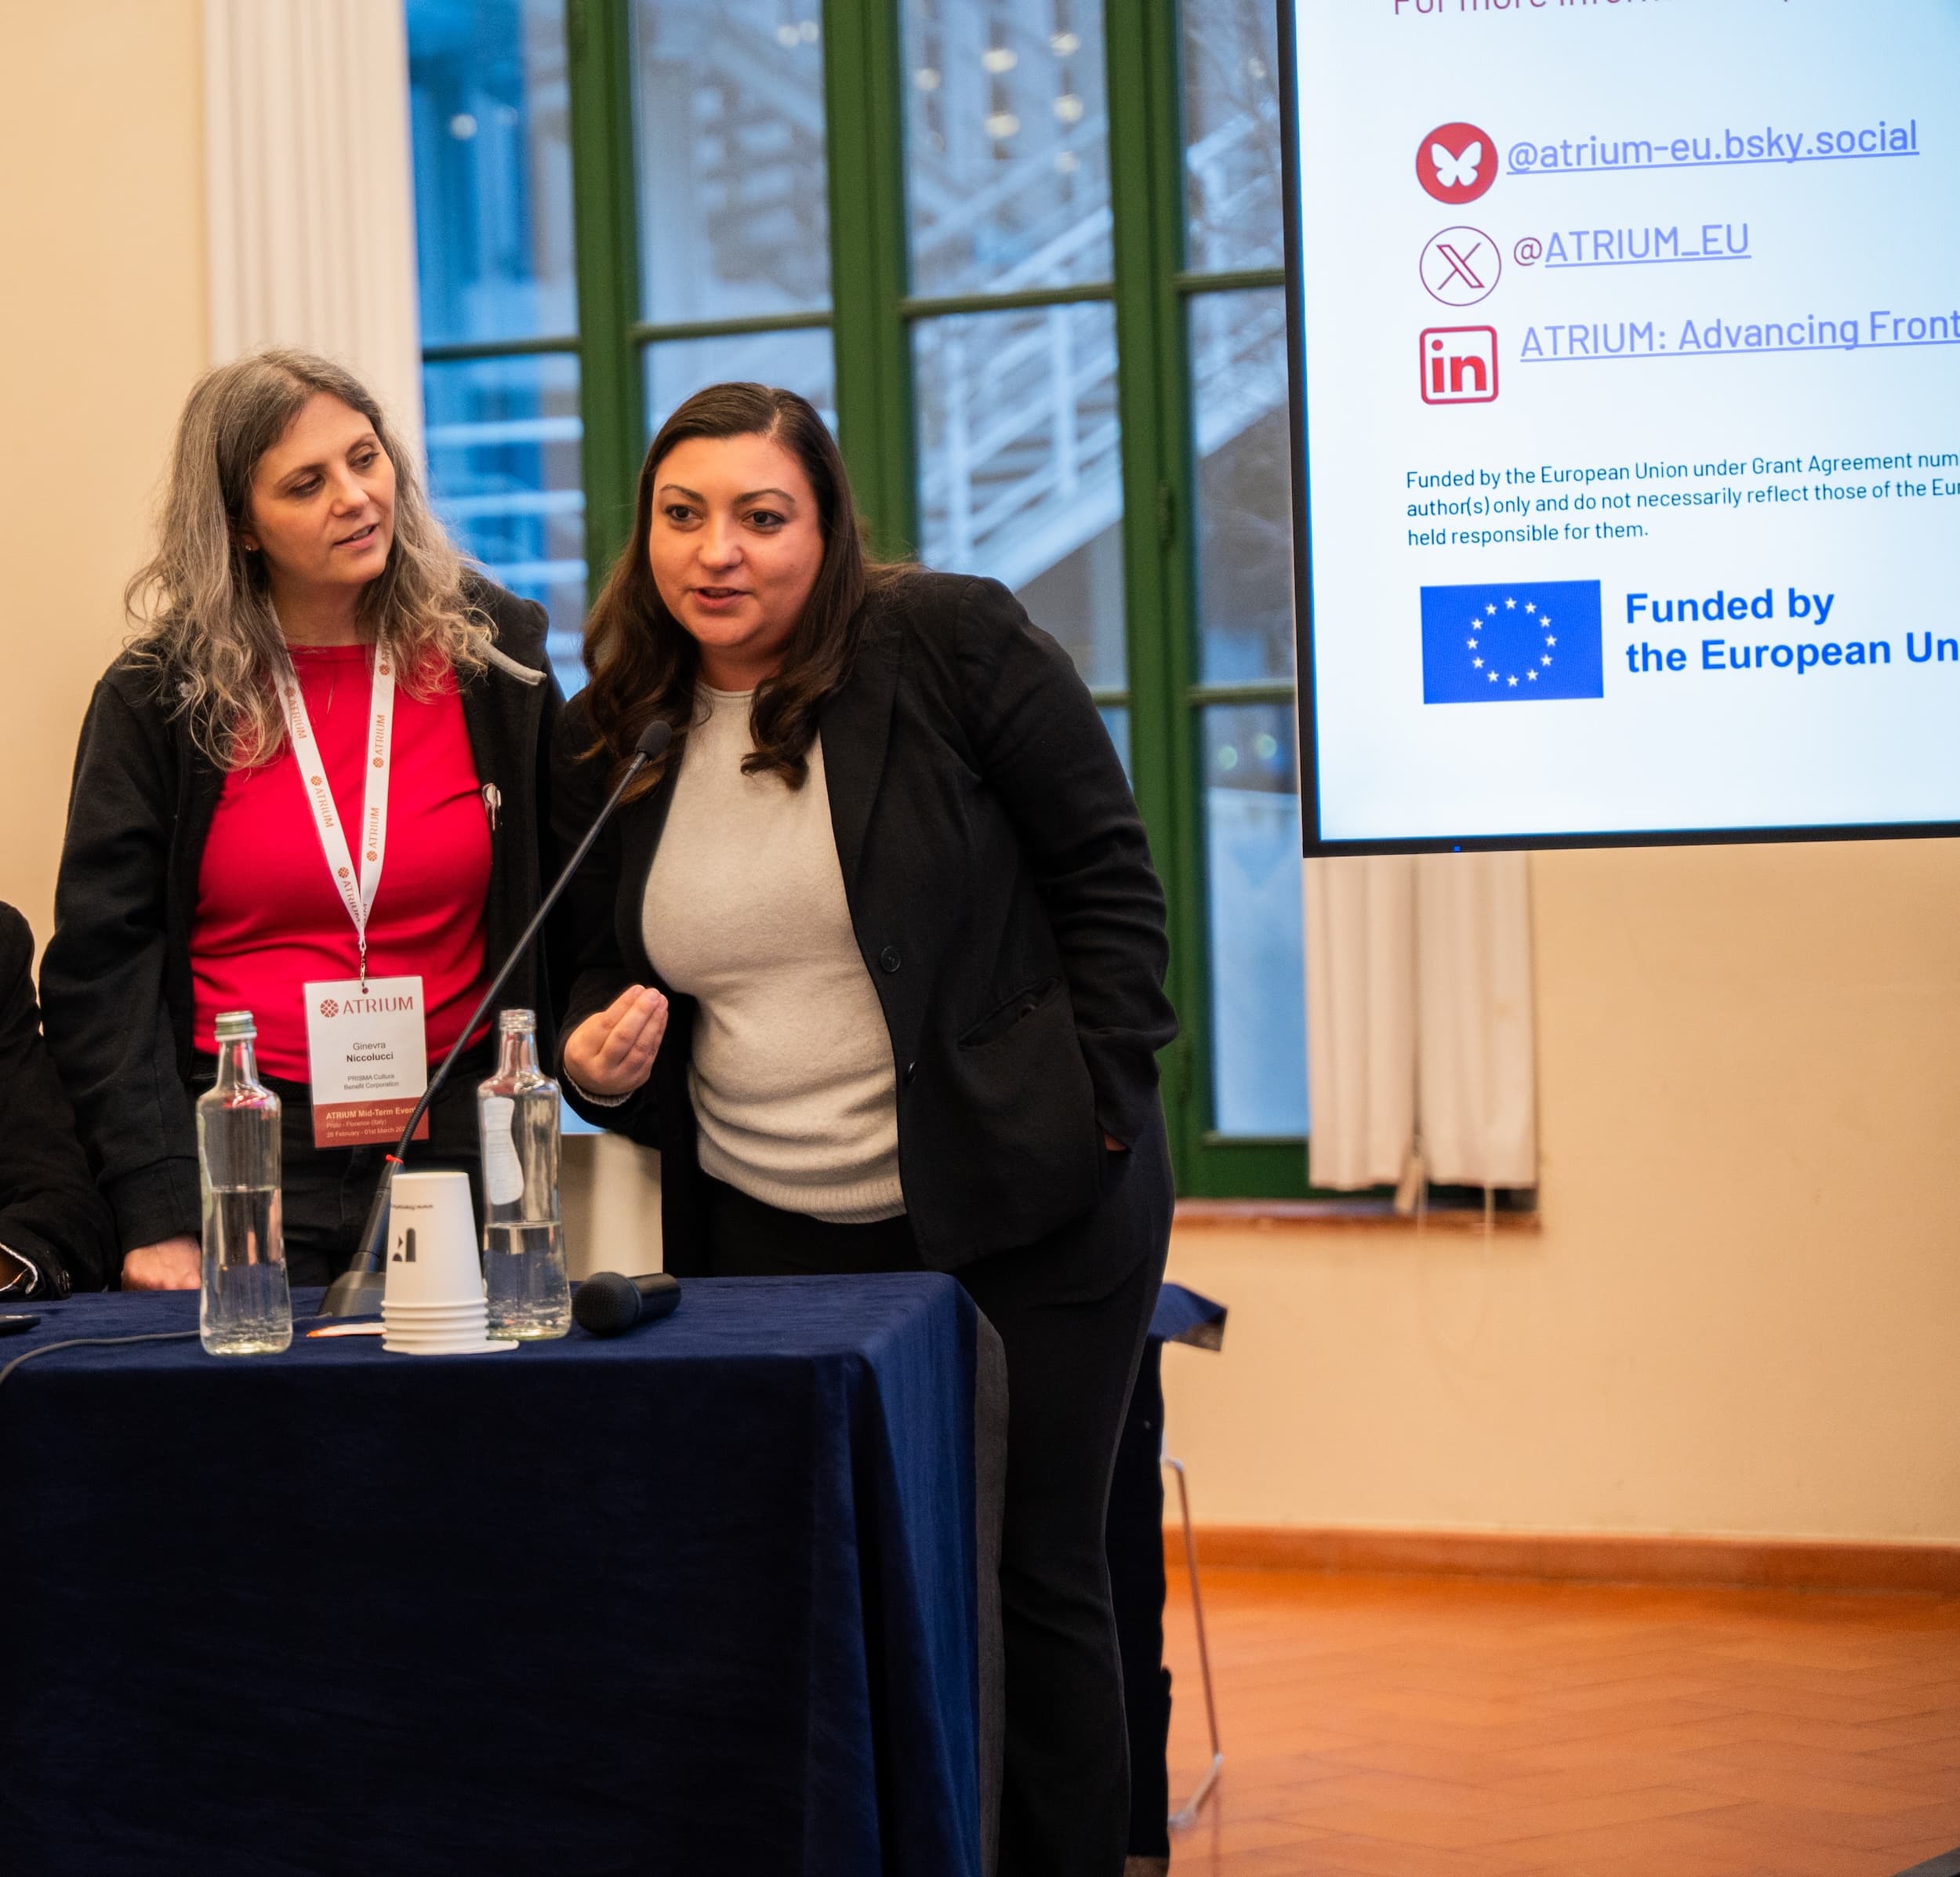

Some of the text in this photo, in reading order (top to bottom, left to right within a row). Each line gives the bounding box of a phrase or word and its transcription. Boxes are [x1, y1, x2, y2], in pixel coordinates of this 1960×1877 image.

[1508, 119, 1917, 173] @atrium-eu.bsky.social
[1513, 223, 1749, 267] @ATRIUM_EU
[1520, 321, 1666, 358] ATRIUM:
[1679, 314, 1859, 351] Advancing
[1406, 470, 1475, 488] Funded
[1479, 469, 1501, 490] by
[1505, 467, 1536, 485] the
[1541, 465, 1630, 485] European
[1635, 461, 1688, 480] Union
[1693, 459, 1748, 477] under
[1751, 456, 1803, 474] Grant
[1808, 452, 1914, 476] Agreement
[1406, 495, 1490, 517] author(s)
[1493, 495, 1531, 517] only
[1535, 493, 1569, 512] and
[1573, 492, 1597, 510] do
[1601, 492, 1632, 509] not
[1636, 486, 1743, 509] necessarily
[1747, 484, 1809, 503] reflect
[1814, 483, 1867, 501] those
[1871, 480, 1892, 499] of
[1895, 479, 1927, 498] the
[1407, 521, 1649, 547] held responsible for them.
[1625, 586, 1835, 626] Funded by
[1625, 630, 1959, 675] the European Un
[374, 714, 386, 756] ATRIUM
[314, 787, 335, 828] ATRIUM
[368, 807, 380, 849] ATRIUM
[343, 996, 414, 1015] ATRIUM
[347, 1051, 394, 1062] Niccolucci
[352, 1041, 387, 1051] Ginevra
[326, 1110, 357, 1120] ATRIUM
[358, 1108, 394, 1118] Mid-Term
